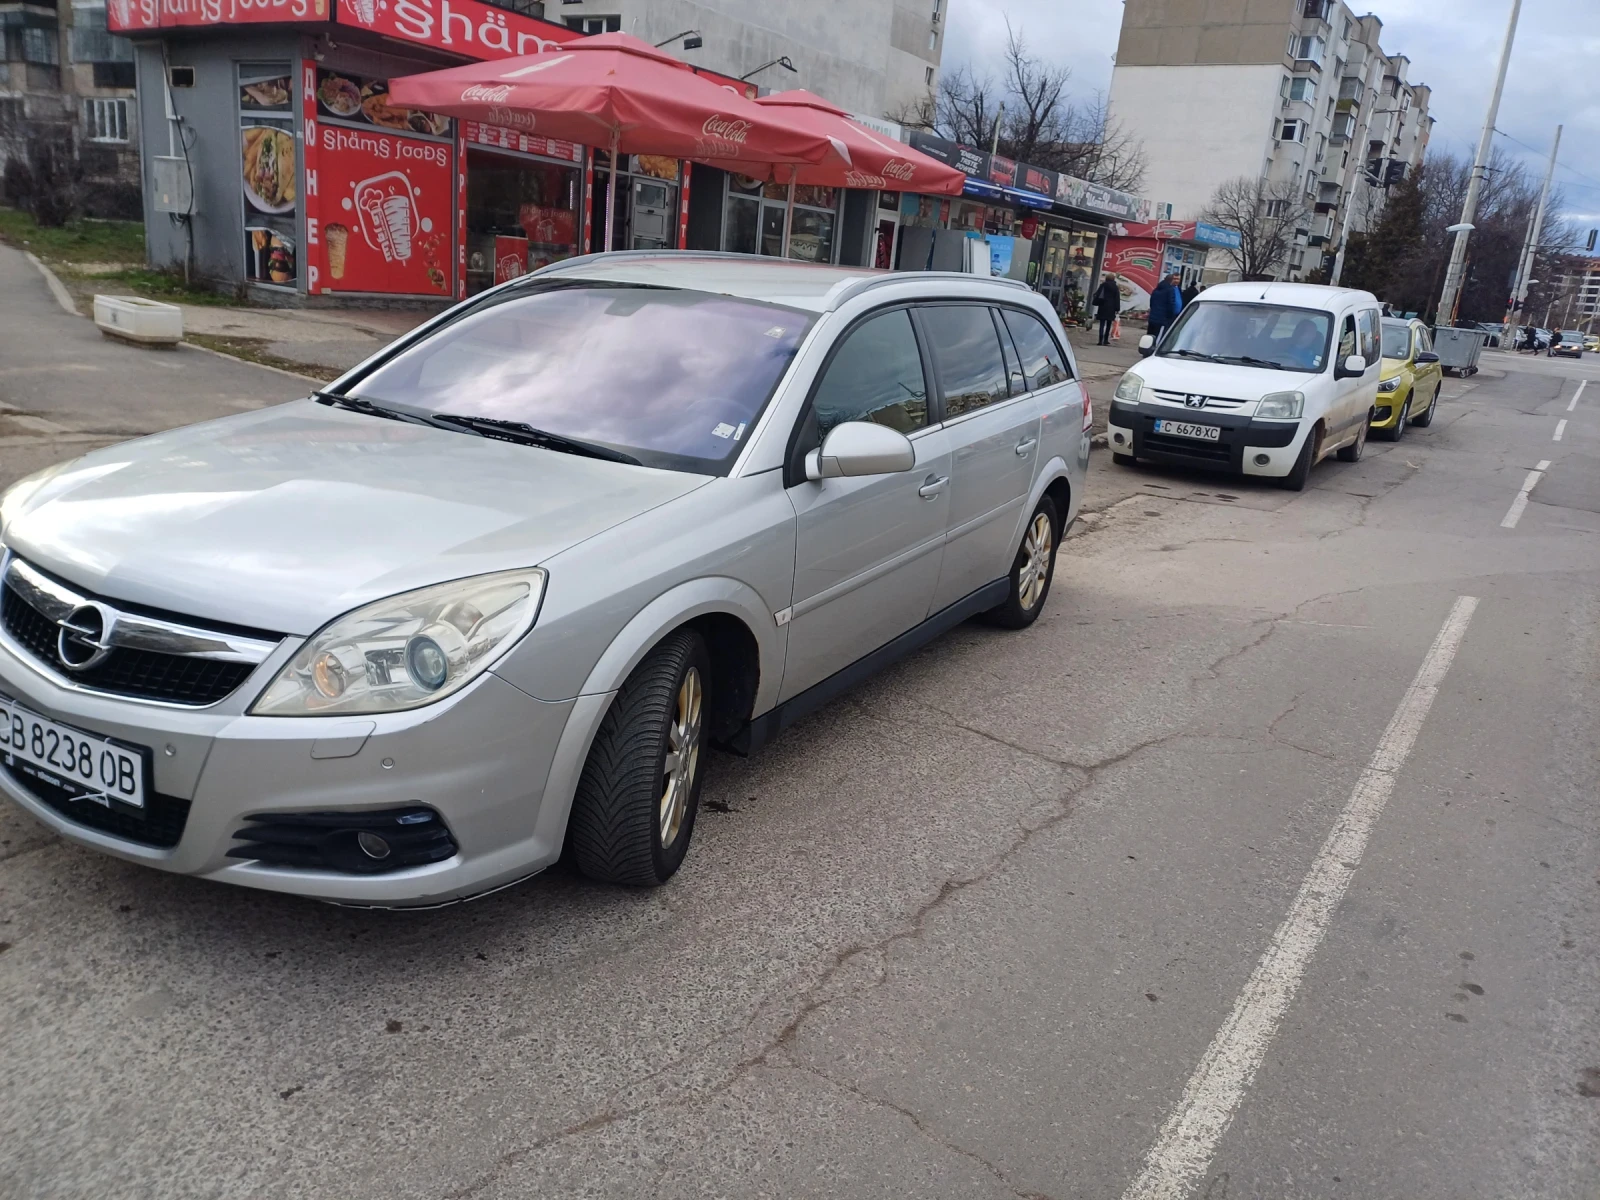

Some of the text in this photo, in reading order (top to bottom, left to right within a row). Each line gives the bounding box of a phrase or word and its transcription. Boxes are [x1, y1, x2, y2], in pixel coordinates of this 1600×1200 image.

[461, 83, 519, 103] Coca-Cola
[702, 114, 753, 145] Coca-Cola
[304, 67, 319, 291] ДЮНЕР
[881, 158, 918, 181] Coca-Cola
[1164, 421, 1219, 439] C 6678 XC
[31, 723, 93, 779] 8238
